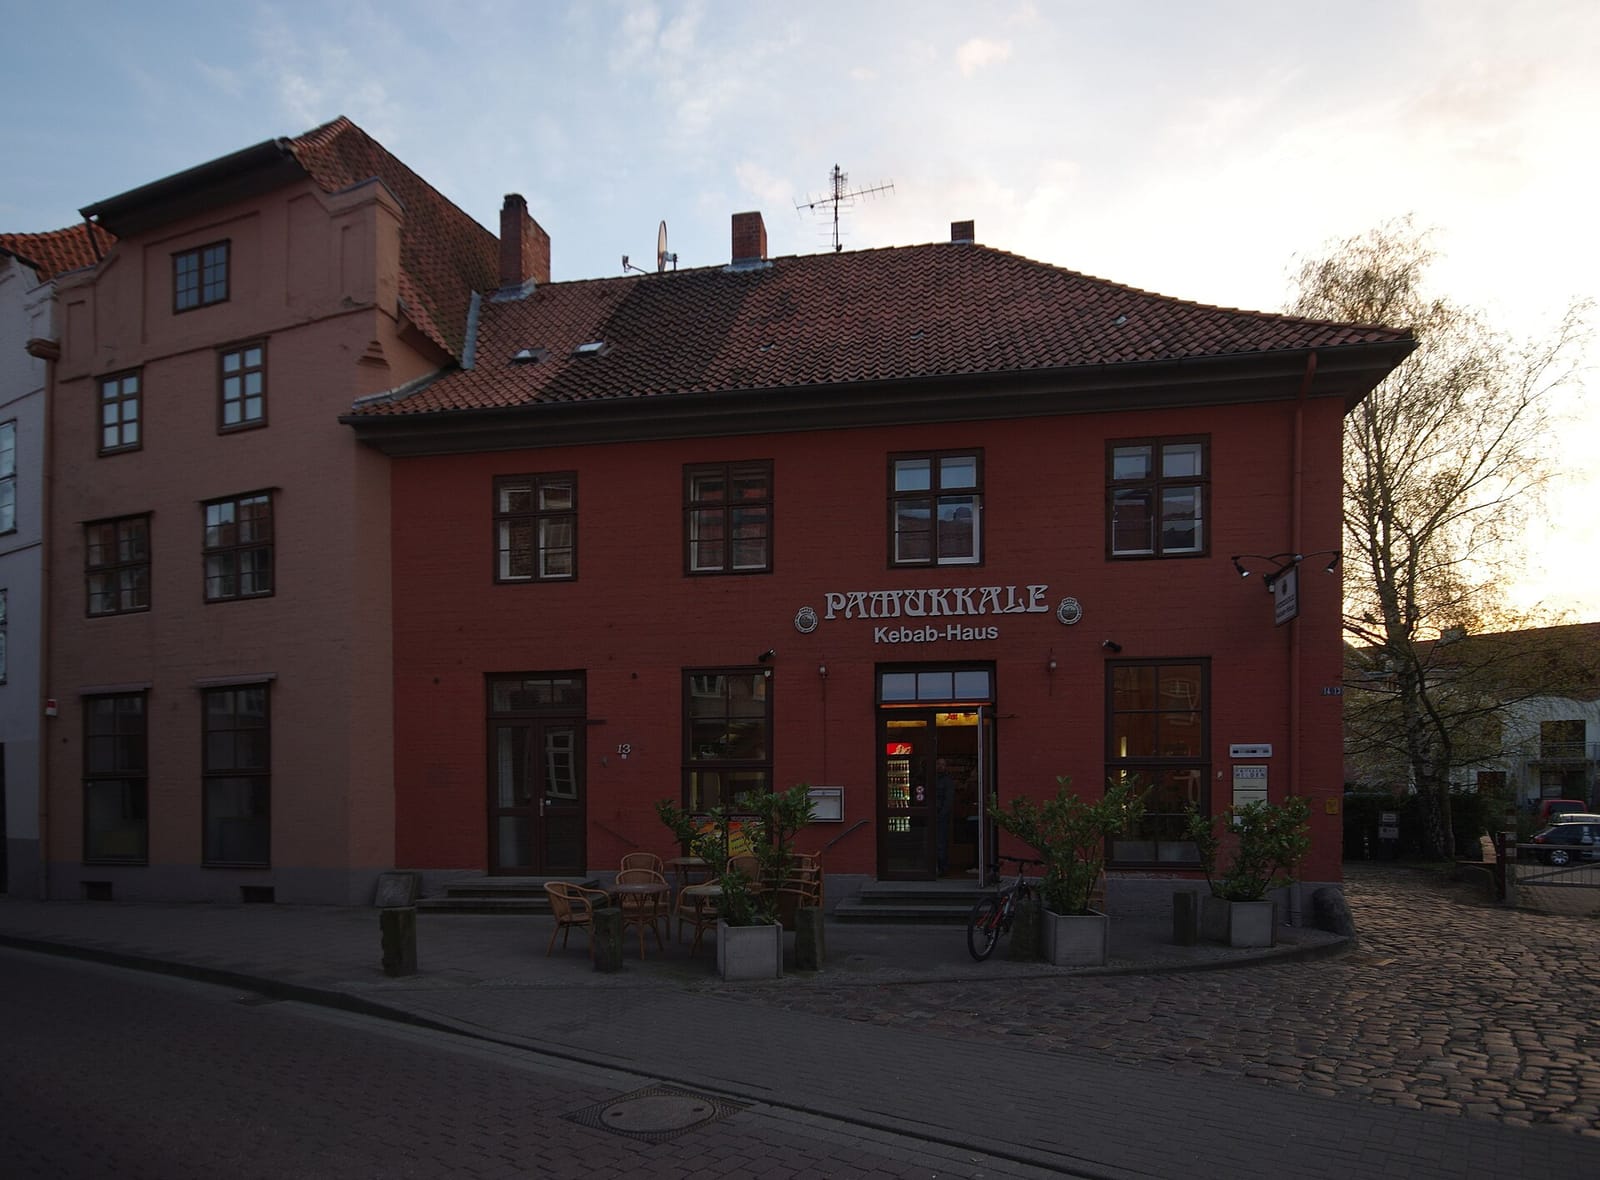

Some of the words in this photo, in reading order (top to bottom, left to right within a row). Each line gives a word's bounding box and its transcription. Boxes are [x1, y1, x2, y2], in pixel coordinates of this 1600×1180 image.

[824, 585, 1049, 620] PAMUKKALE
[874, 624, 998, 644] Kebab-Haus
[616, 743, 631, 754] 13
